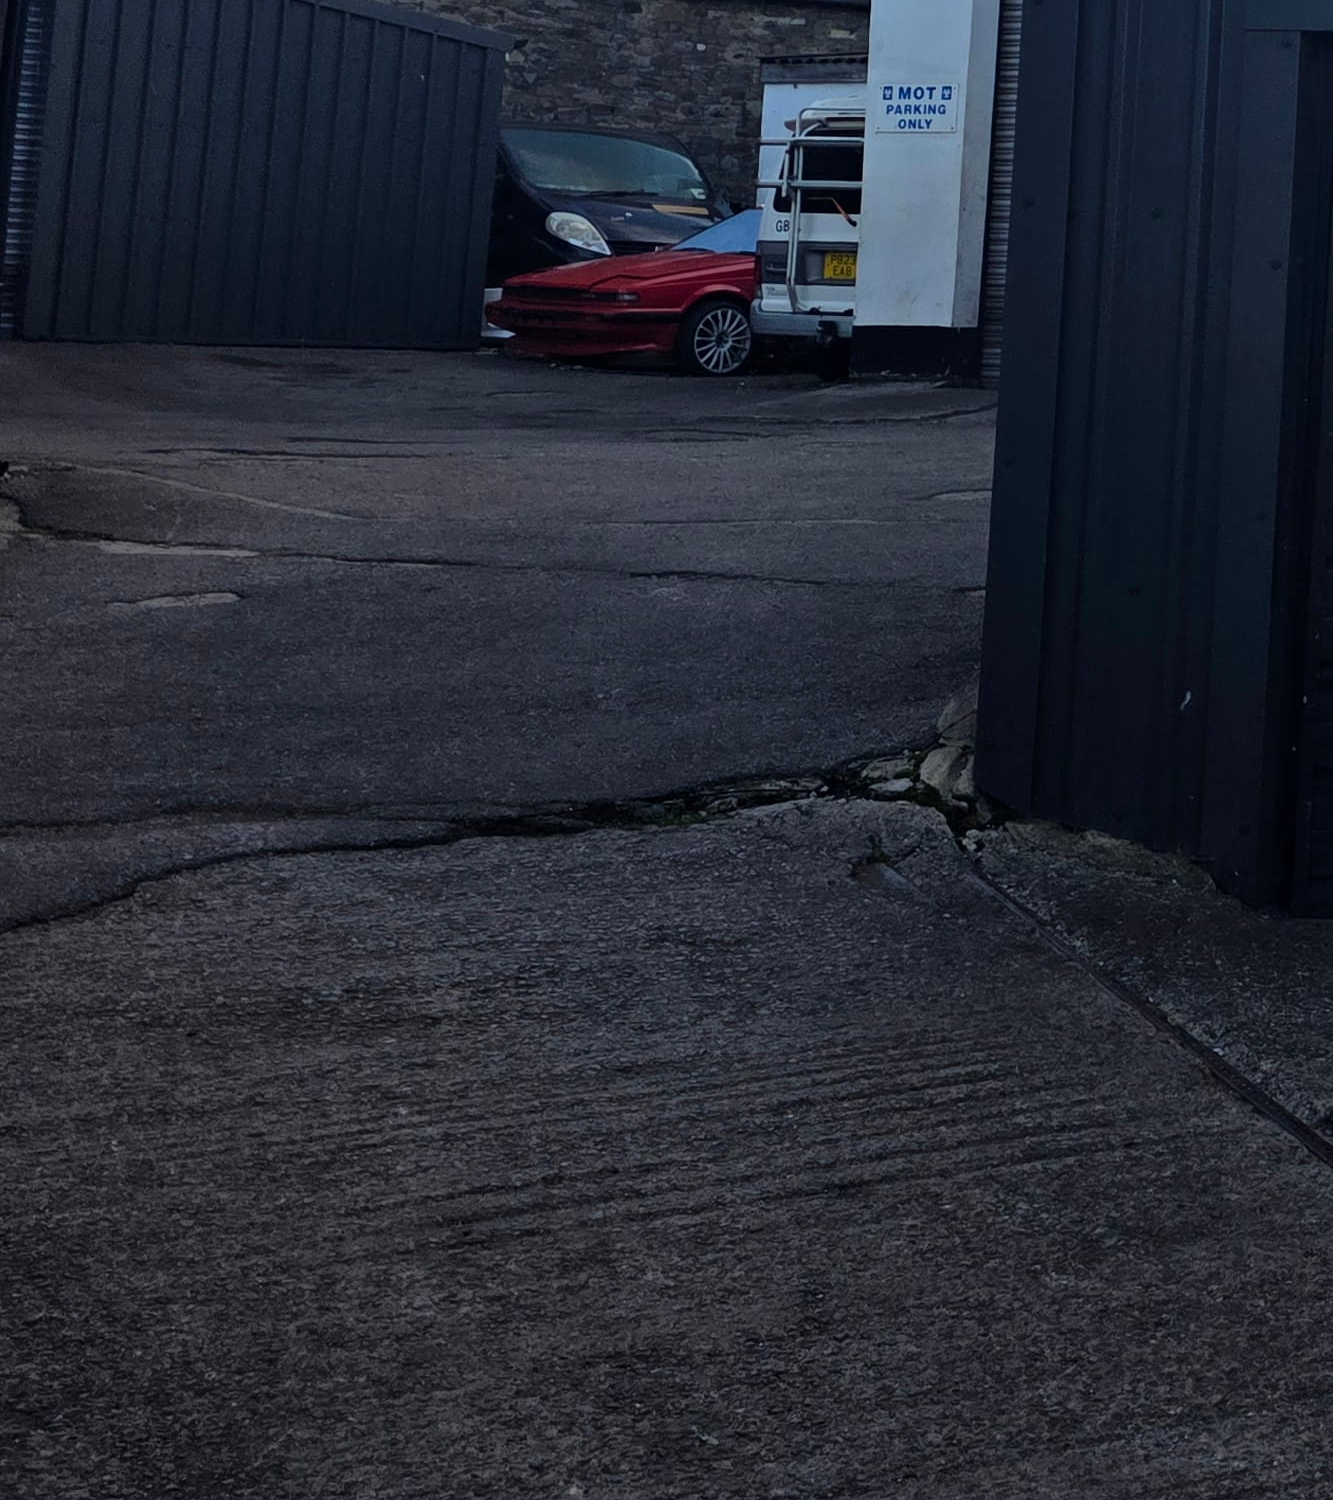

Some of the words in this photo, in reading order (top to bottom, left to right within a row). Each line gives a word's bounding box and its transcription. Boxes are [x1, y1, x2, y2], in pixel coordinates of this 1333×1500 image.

[898, 86, 937, 100] MOT
[886, 104, 947, 115] PARKING
[898, 119, 933, 129] ONLY
[776, 220, 790, 232] GB
